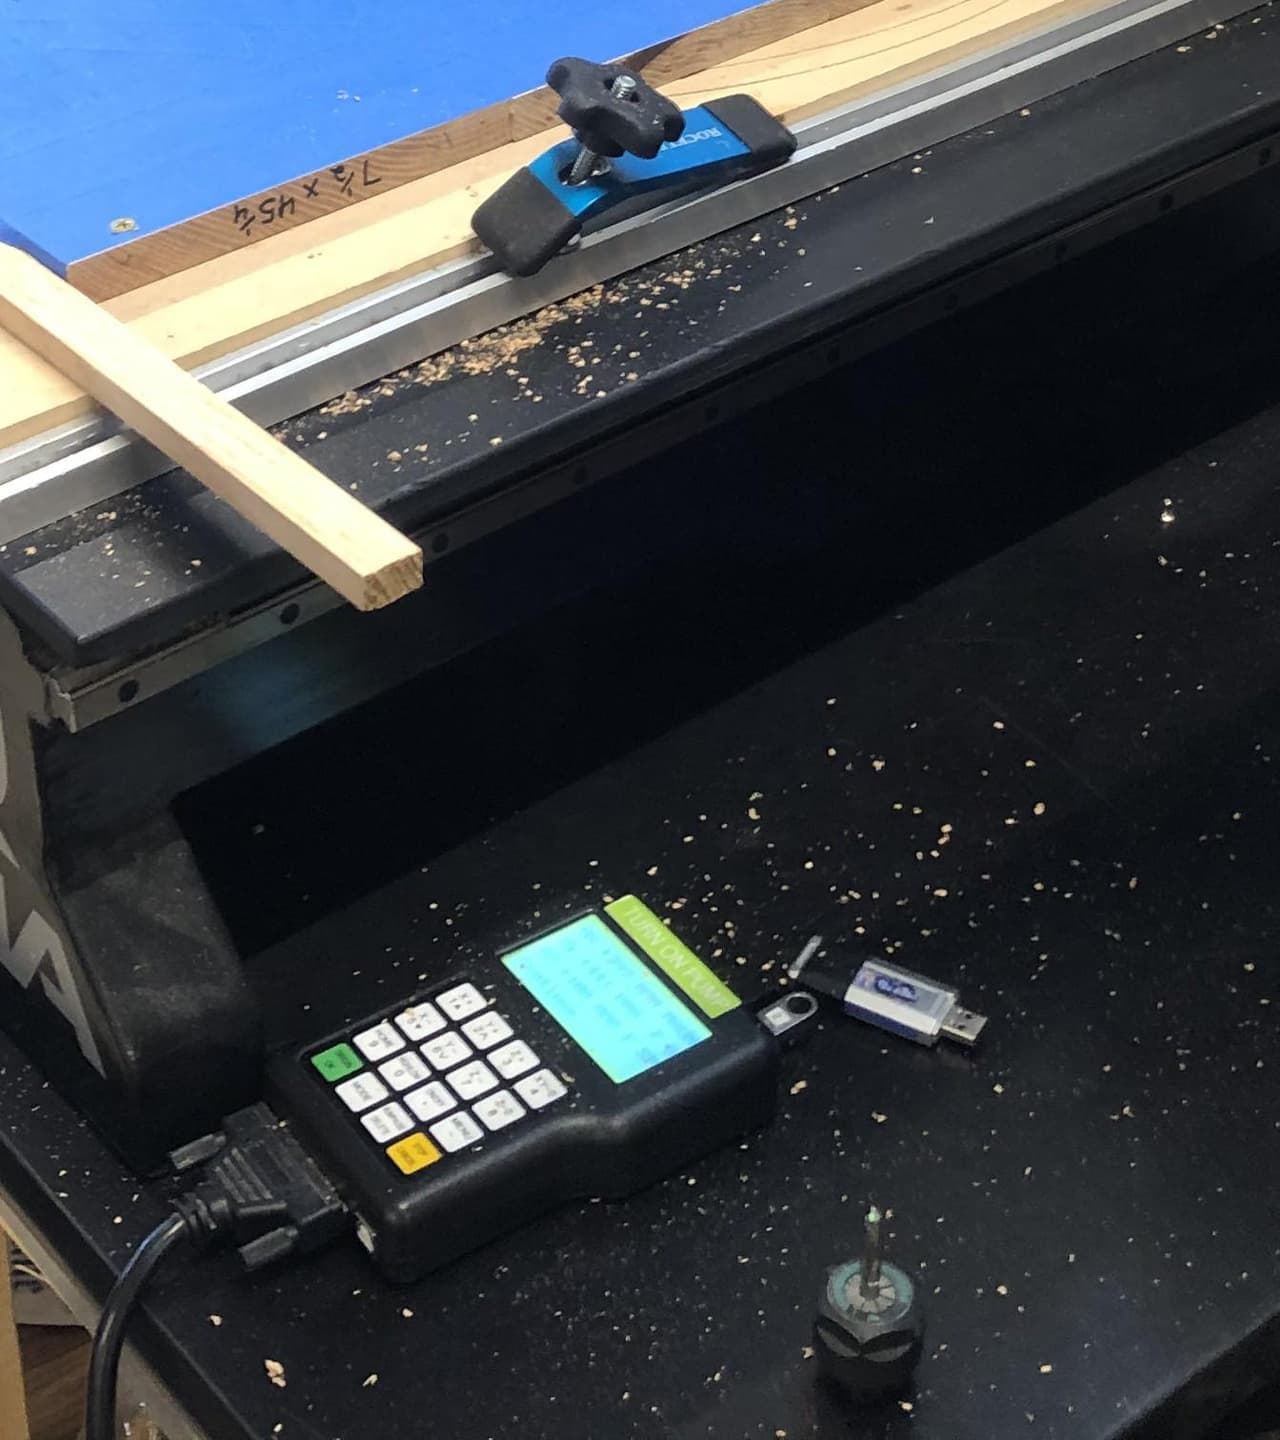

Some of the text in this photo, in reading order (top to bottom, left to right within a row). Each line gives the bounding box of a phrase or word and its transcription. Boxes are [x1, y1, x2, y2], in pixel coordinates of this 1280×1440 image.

[625, 907, 730, 1009] TURN ON PUMP
